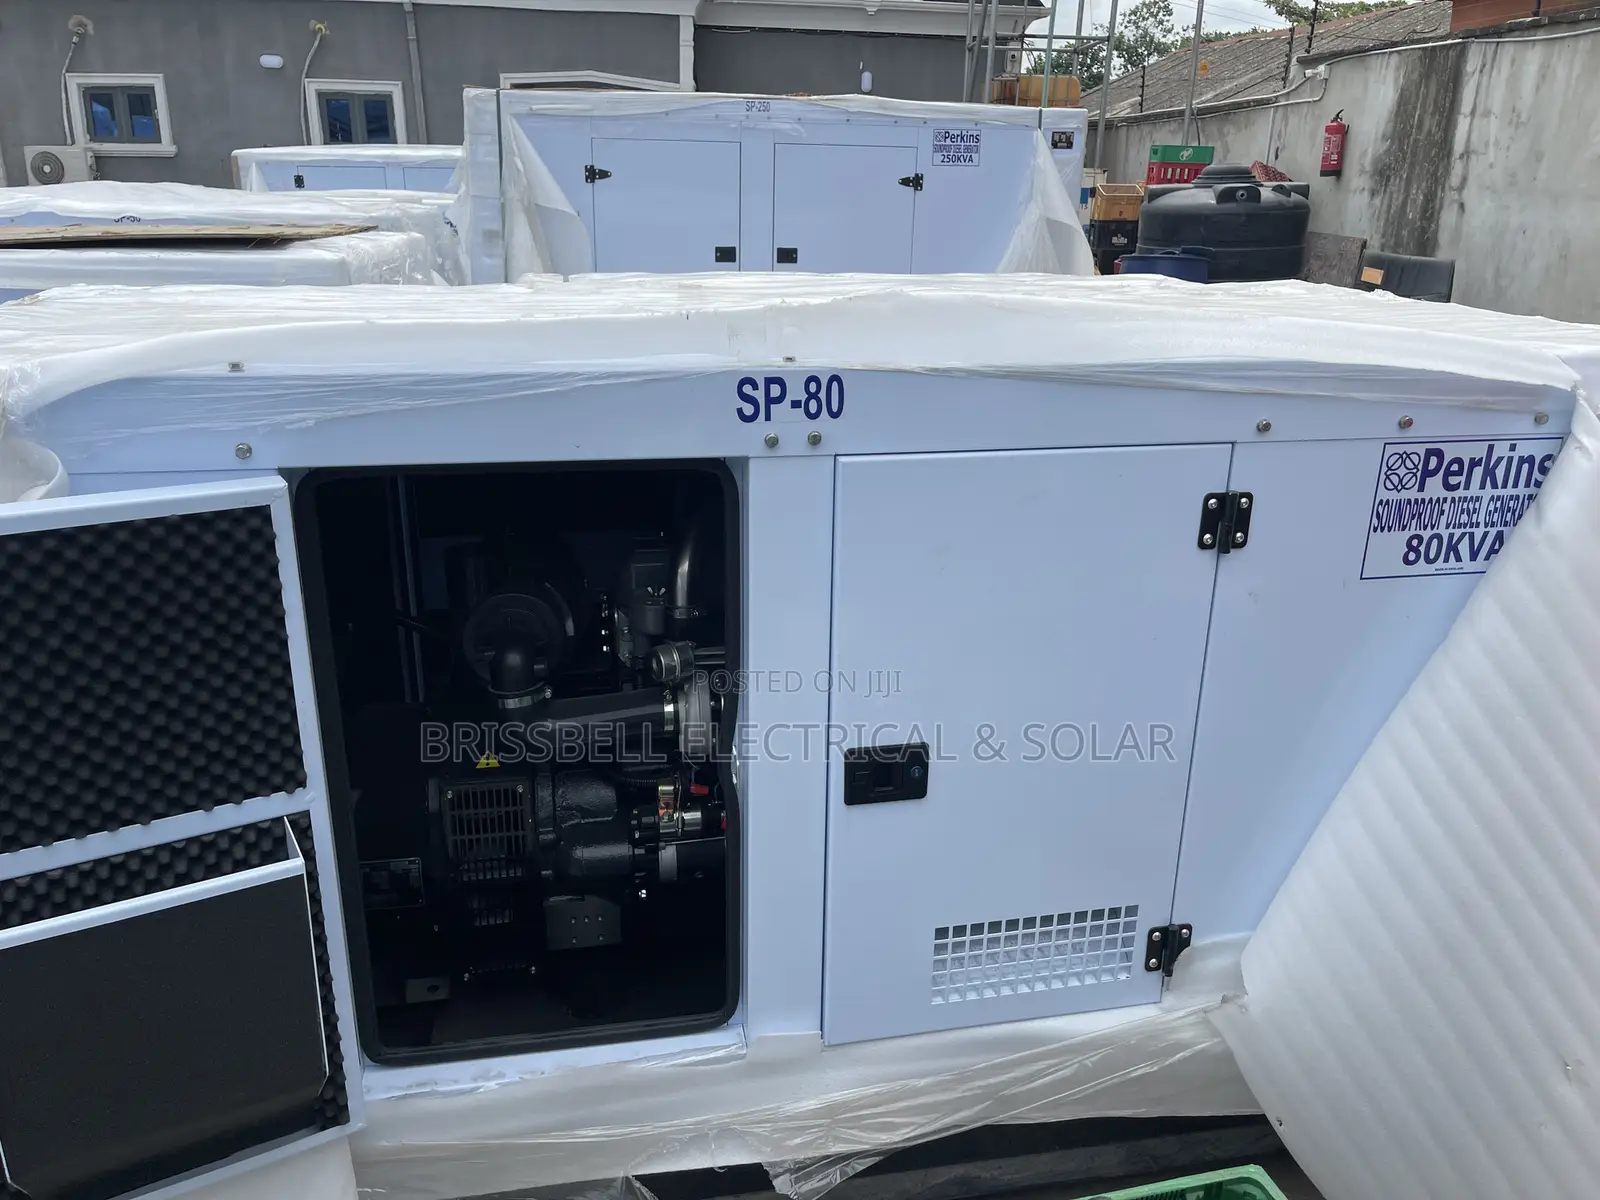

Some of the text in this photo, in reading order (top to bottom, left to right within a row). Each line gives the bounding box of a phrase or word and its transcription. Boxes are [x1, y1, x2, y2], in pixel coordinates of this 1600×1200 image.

[745, 100, 771, 113] SP-250
[944, 130, 980, 144] Perkins
[940, 154, 974, 163] 250KVA
[736, 374, 845, 423] SP-80
[1417, 443, 1556, 493] Perkins
[1372, 493, 1539, 533] SOUNDPROOF DIESEL GENERAT
[1402, 530, 1505, 566] 80KVA
